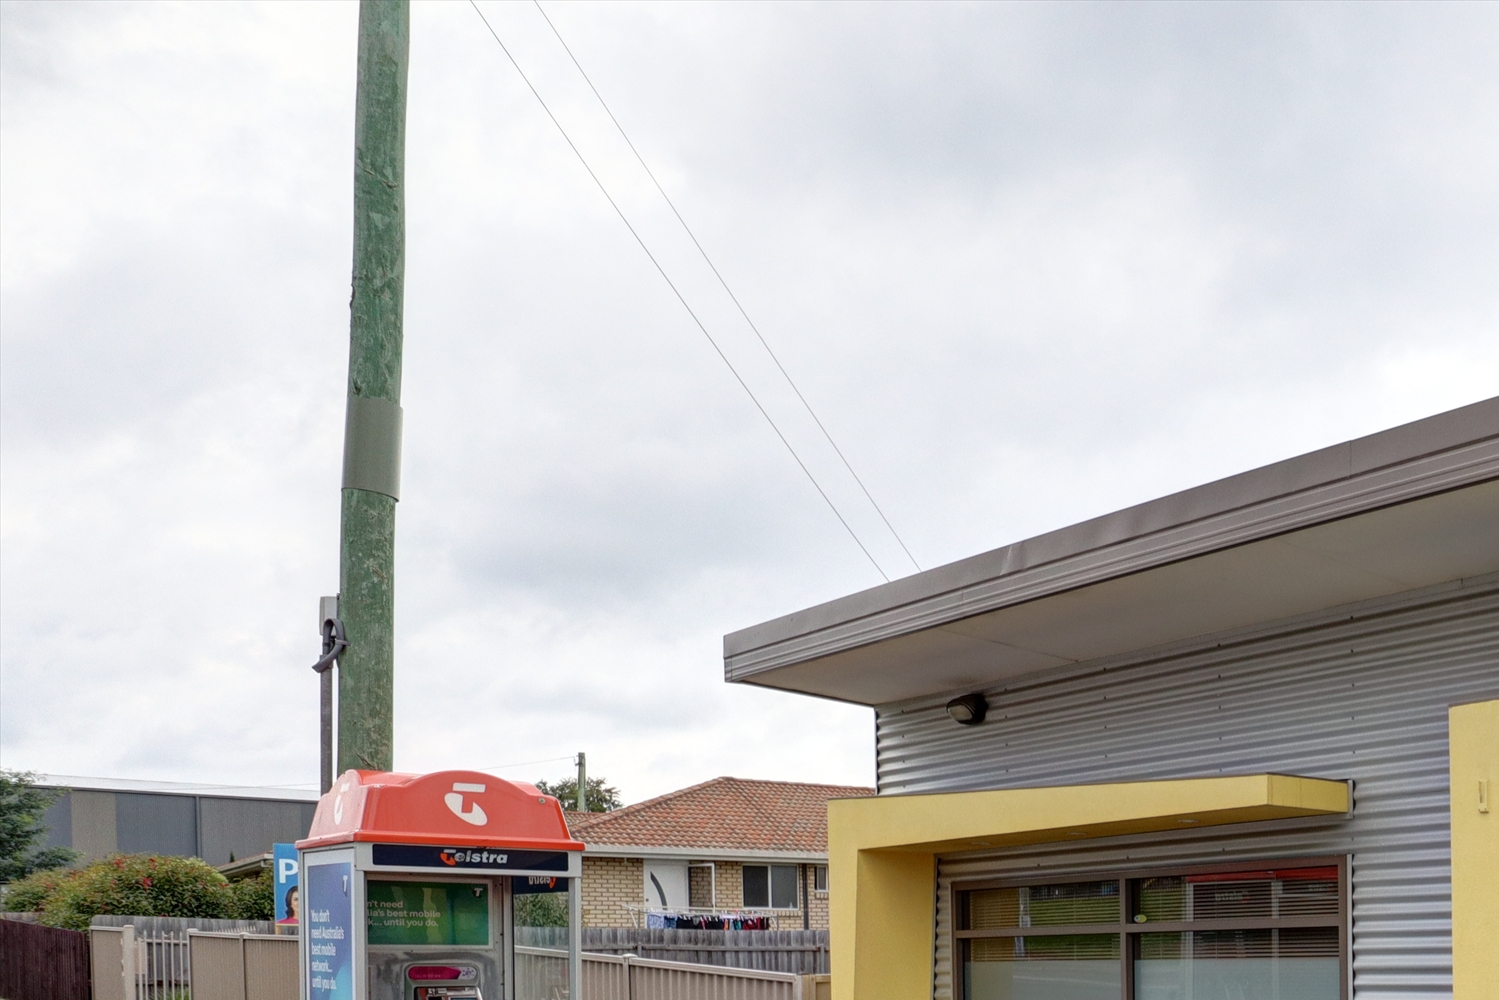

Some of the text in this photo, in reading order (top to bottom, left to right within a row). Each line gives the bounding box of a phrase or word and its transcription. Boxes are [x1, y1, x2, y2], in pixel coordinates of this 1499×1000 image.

[440, 849, 508, 866] Telstra
[311, 909, 330, 922] You don't
[409, 910, 441, 918] mobile
[407, 920, 423, 928] you
[425, 919, 439, 927] do.
[311, 925, 344, 940] need Australia's
[312, 942, 336, 956] best mobile
